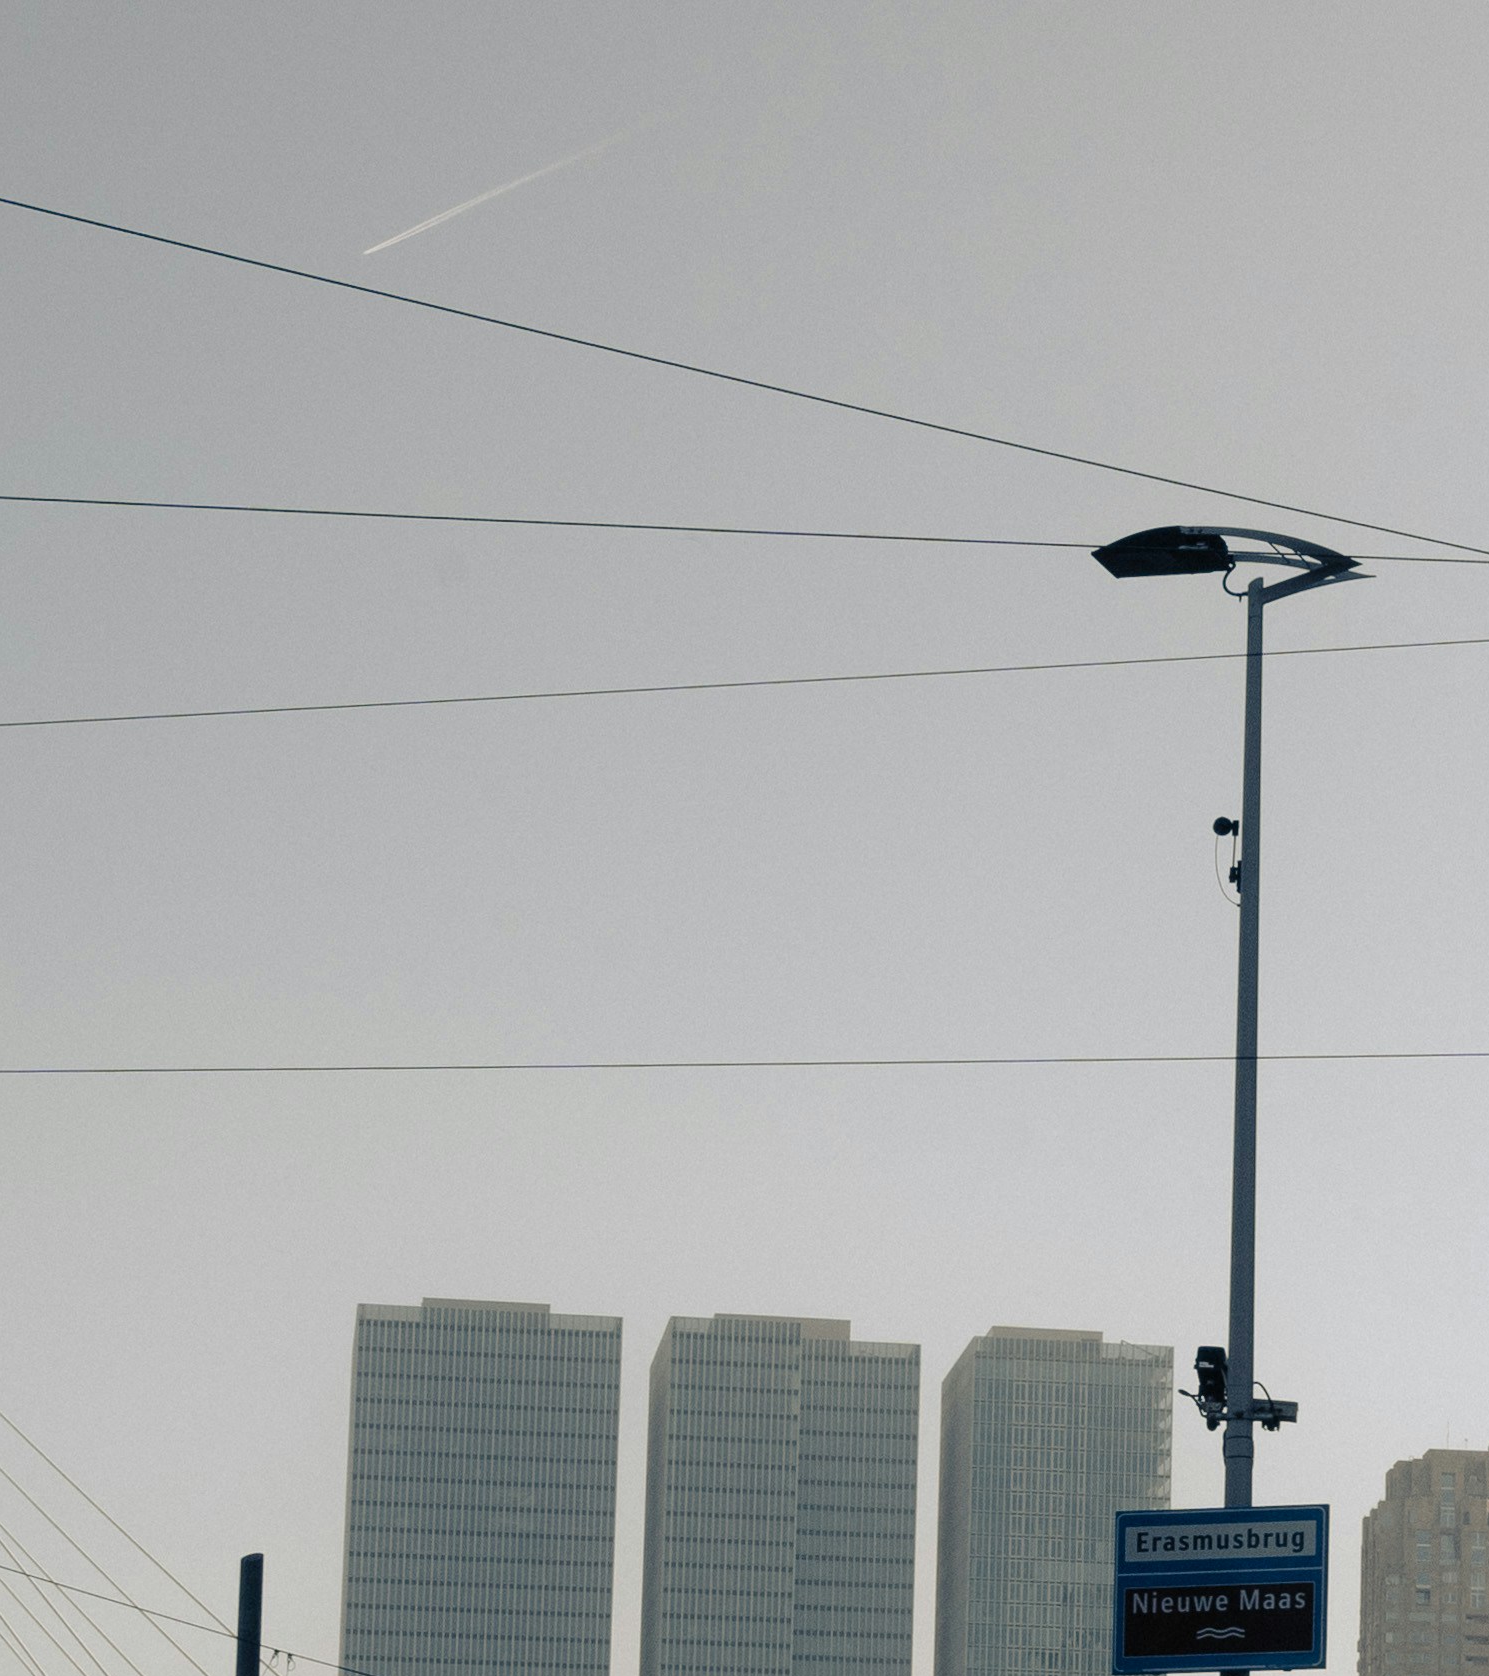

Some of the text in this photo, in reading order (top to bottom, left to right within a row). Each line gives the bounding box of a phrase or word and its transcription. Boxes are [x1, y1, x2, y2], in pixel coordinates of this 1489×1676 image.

[1136, 1528, 1305, 1553] Erasmusbrug
[1132, 1588, 1307, 1615] Nieuwe Maas
